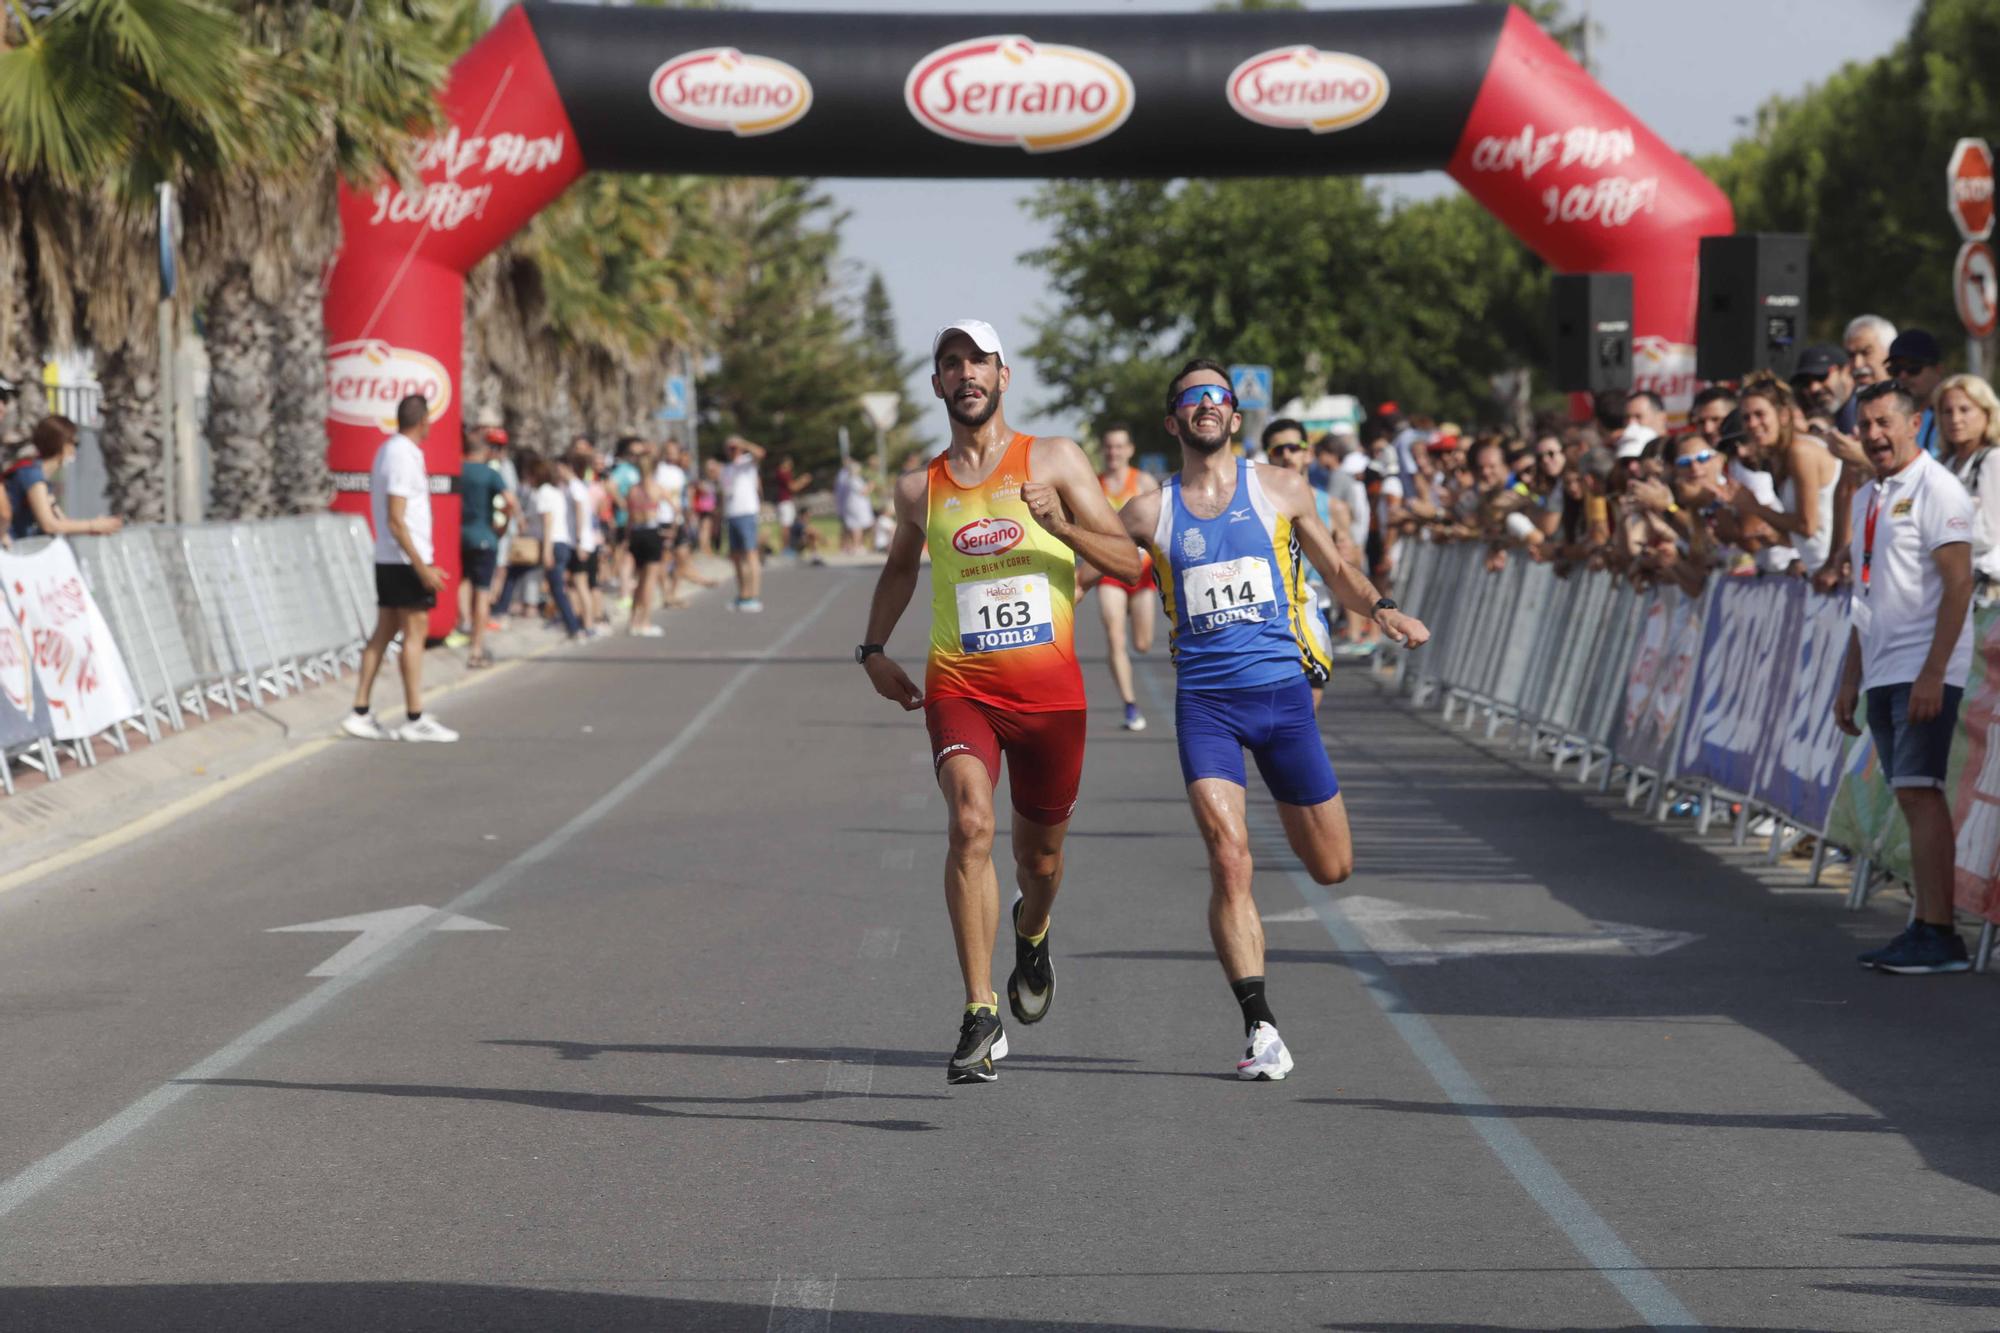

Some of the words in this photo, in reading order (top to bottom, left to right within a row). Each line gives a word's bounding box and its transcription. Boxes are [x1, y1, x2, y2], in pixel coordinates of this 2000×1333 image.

[673, 72, 794, 106] Serrano
[934, 69, 1109, 115] Serrano
[1252, 71, 1371, 105] Serrano
[328, 368, 437, 401] errano
[960, 526, 1018, 550] Serrano
[961, 566, 980, 578] COME
[981, 561, 999, 574] BIEN
[1000, 560, 1005, 569] Y
[1007, 555, 1032, 568] CORRE
[1205, 581, 1256, 609] 114
[978, 601, 1031, 629] 163
